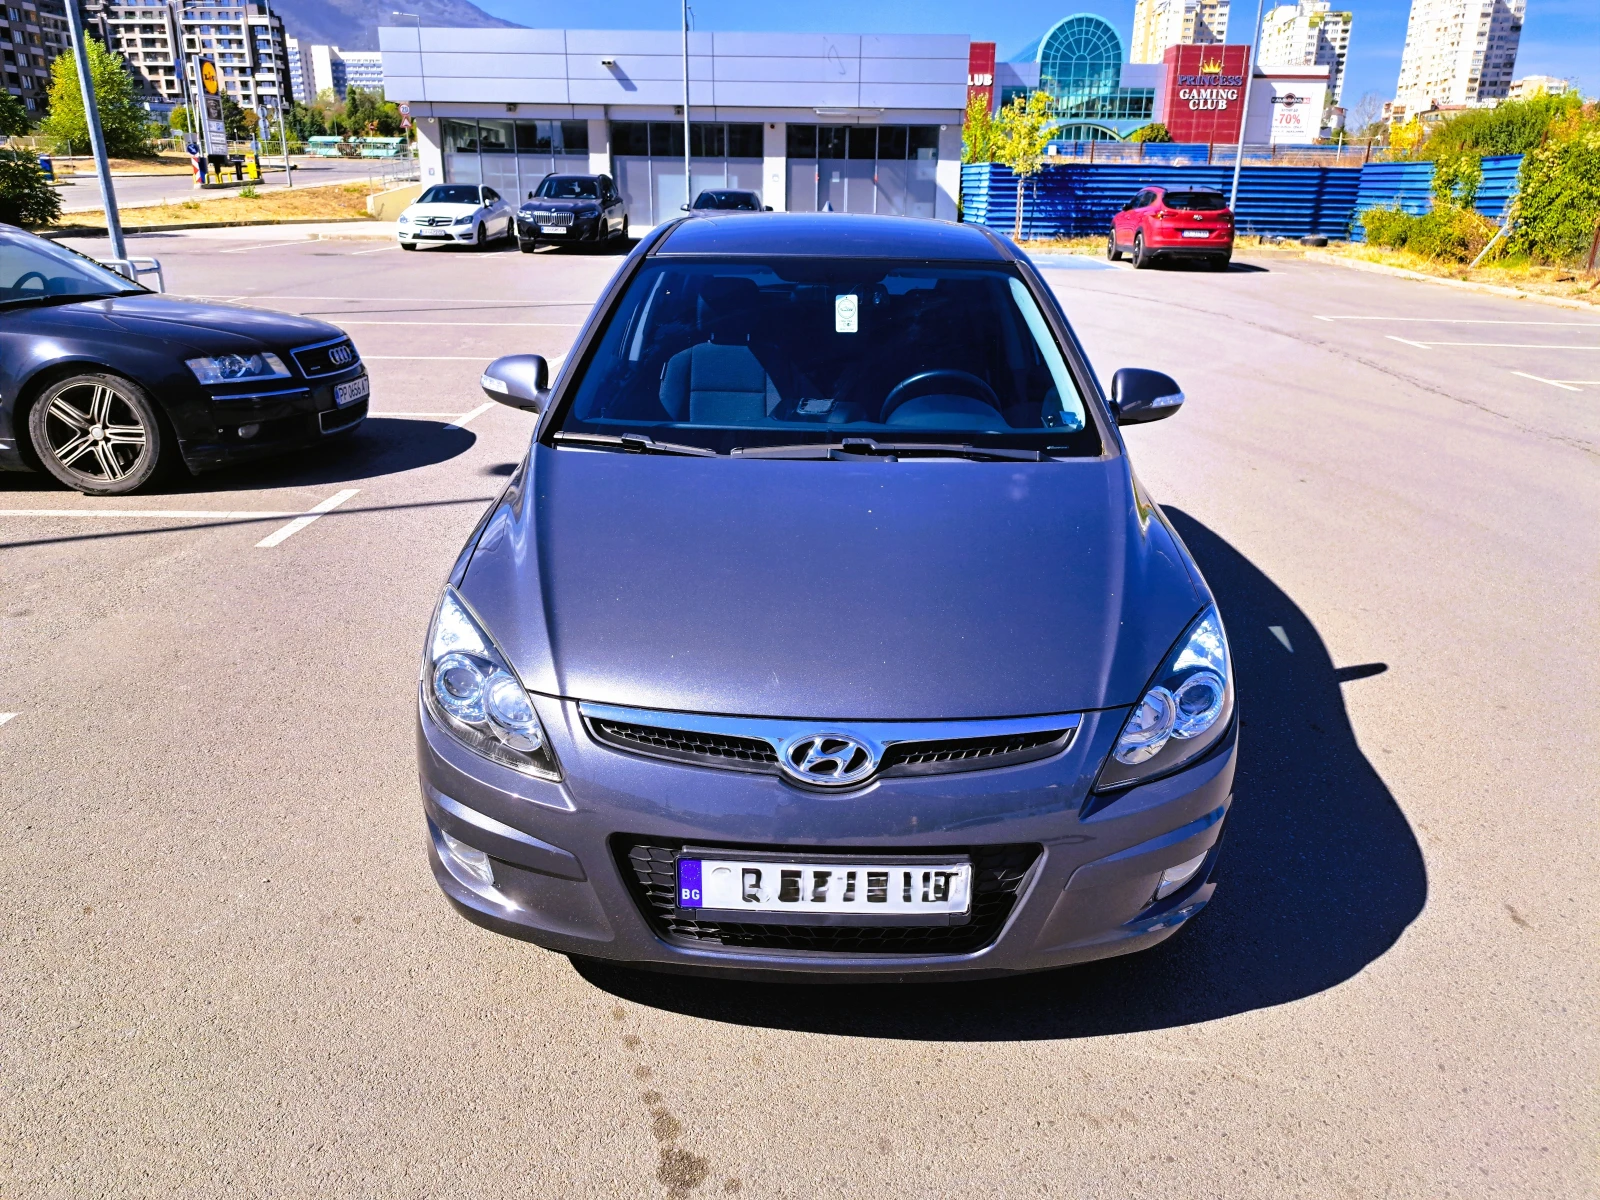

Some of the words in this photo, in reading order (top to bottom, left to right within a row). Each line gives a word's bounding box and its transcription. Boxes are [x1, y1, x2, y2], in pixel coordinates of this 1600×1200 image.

[967, 74, 993, 86] LUB
[1178, 75, 1243, 86] PRINCESS
[1179, 88, 1238, 100] GAMING
[1188, 99, 1227, 110] CLUB
[1274, 113, 1301, 125] -70%
[681, 888, 700, 900] BG
